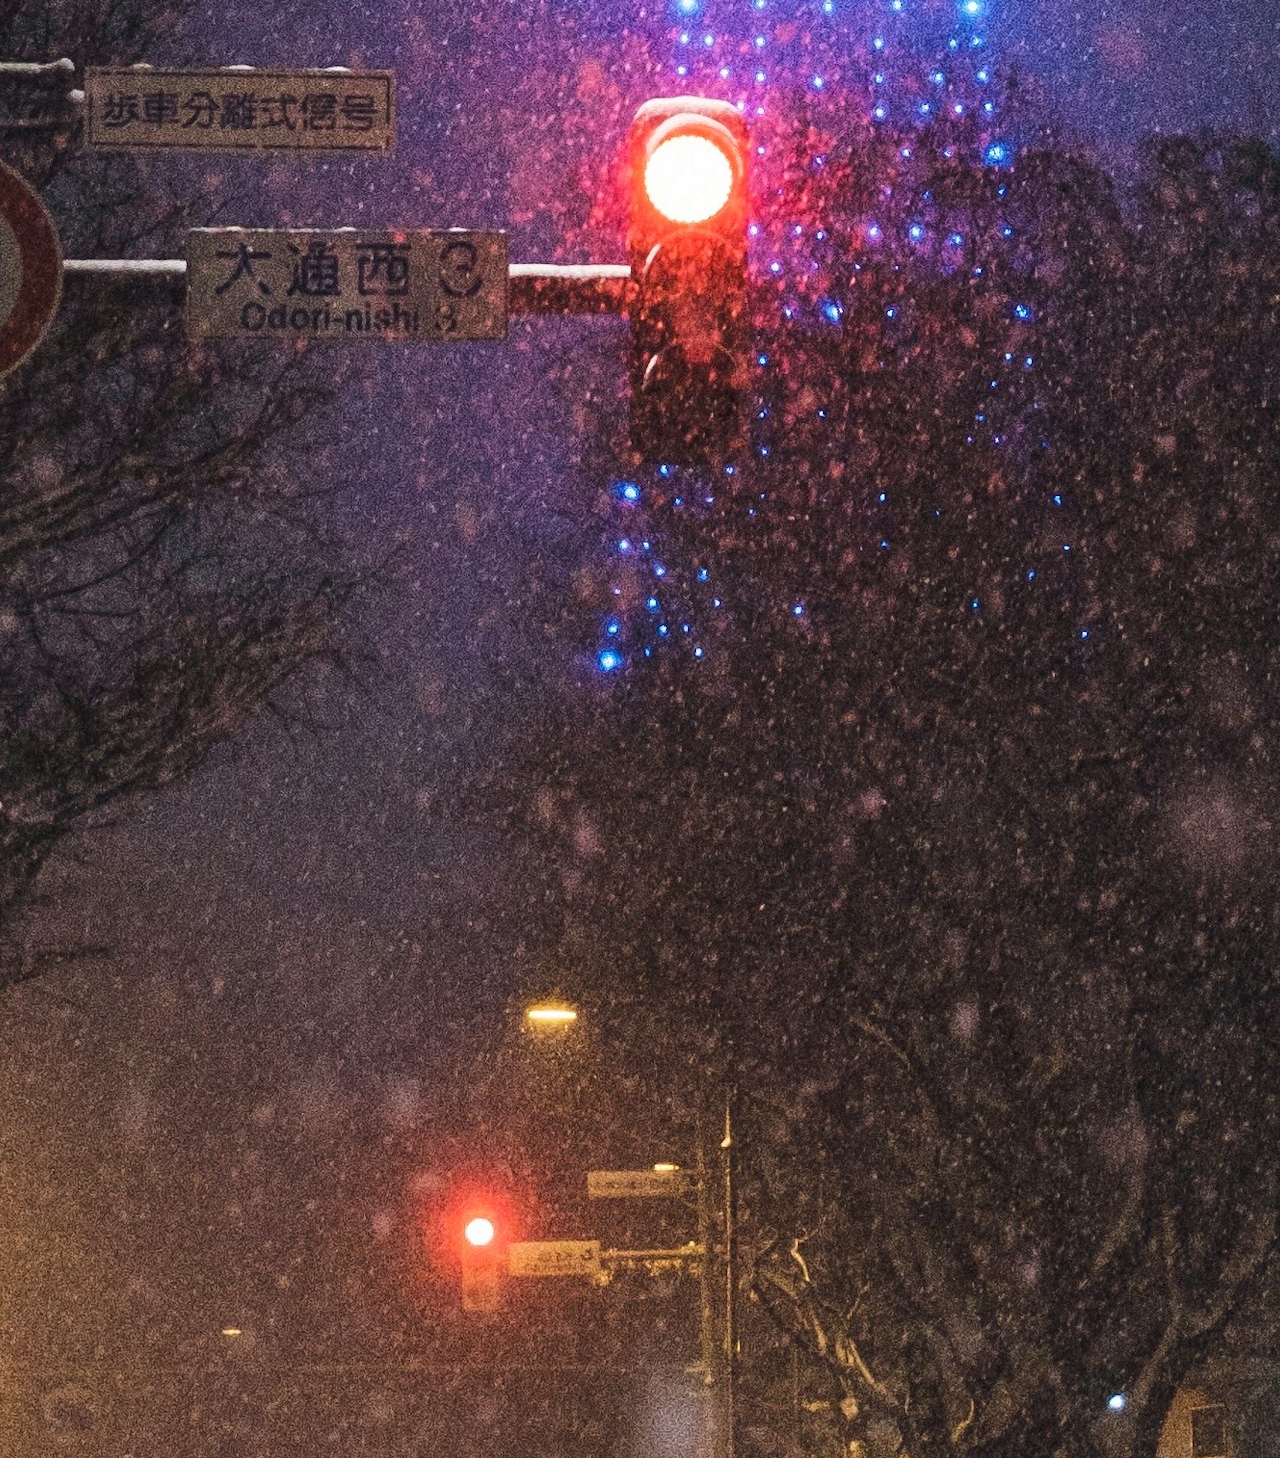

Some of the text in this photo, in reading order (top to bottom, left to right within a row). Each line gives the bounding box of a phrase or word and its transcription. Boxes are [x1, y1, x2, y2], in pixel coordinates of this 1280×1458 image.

[104, 90, 378, 132] 歩車分離式信号
[240, 301, 420, 332] Odori-nishi
